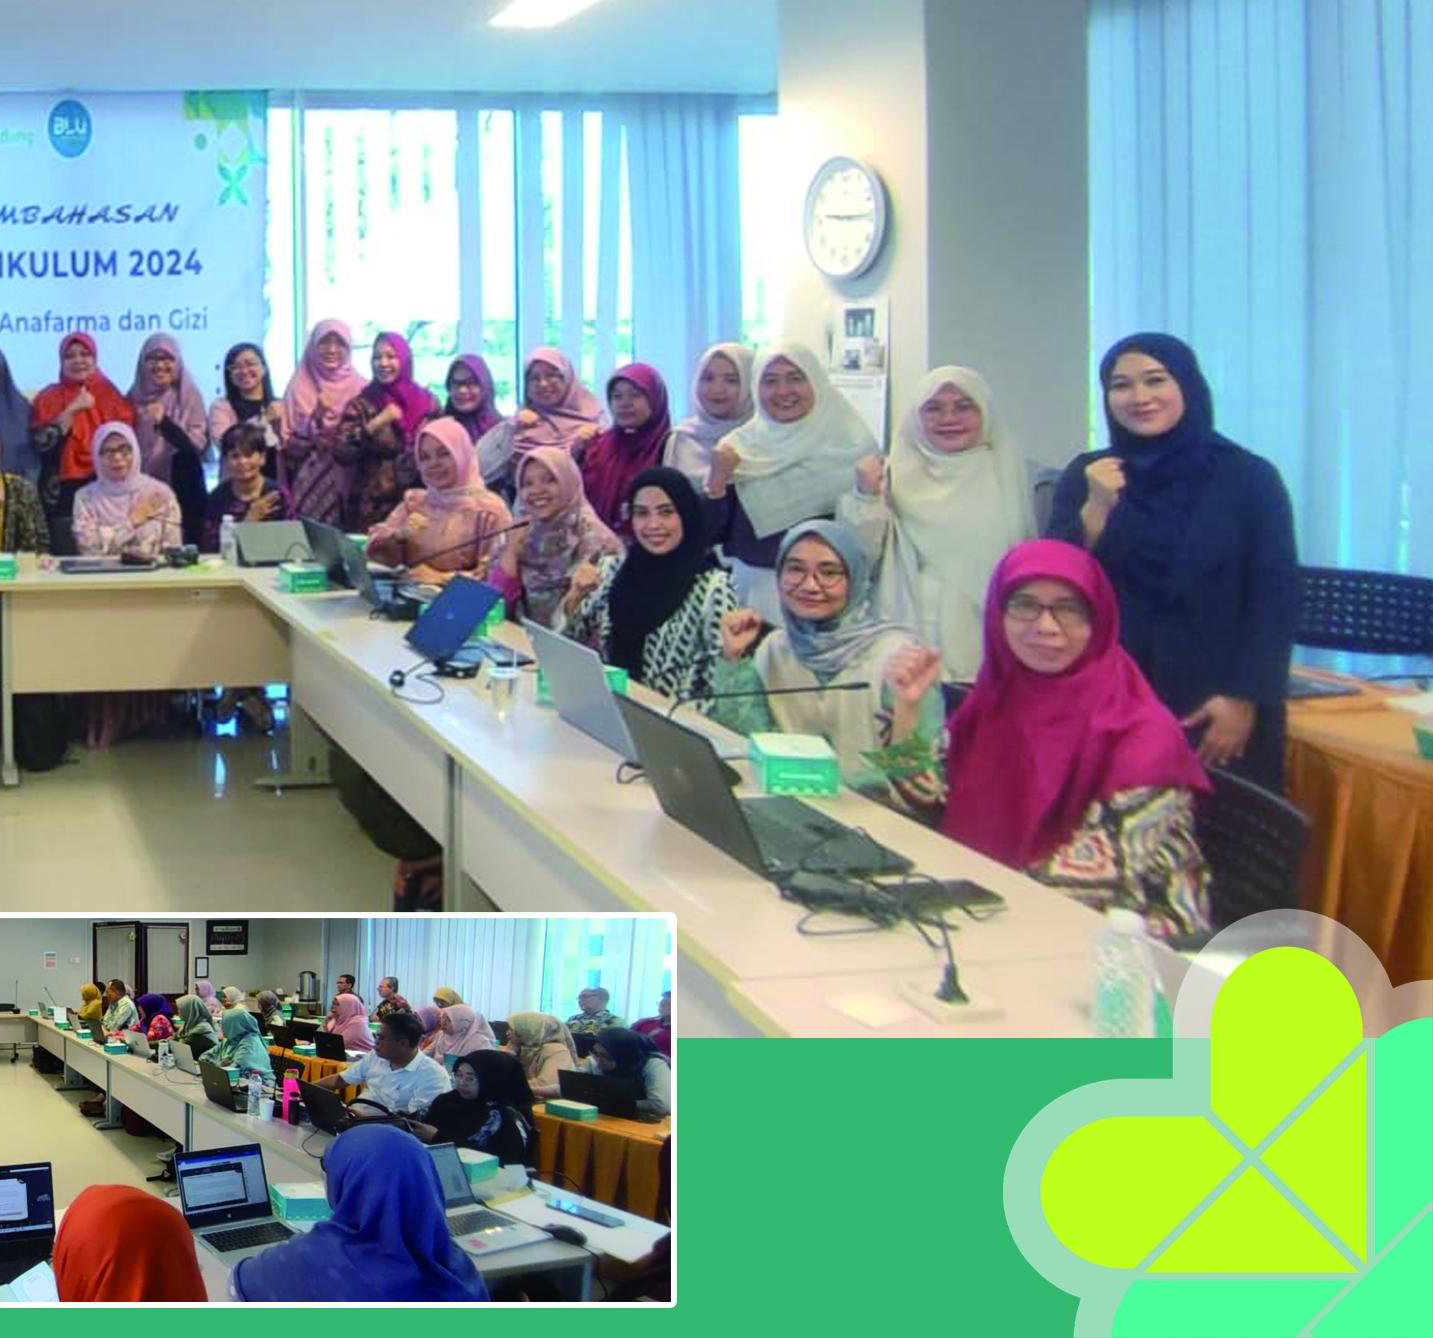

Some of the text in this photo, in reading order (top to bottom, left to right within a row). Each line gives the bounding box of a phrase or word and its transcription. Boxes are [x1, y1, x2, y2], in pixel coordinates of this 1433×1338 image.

[128, 248, 203, 277] 2024
[118, 309, 161, 331] dan
[168, 306, 208, 330] Gizi
